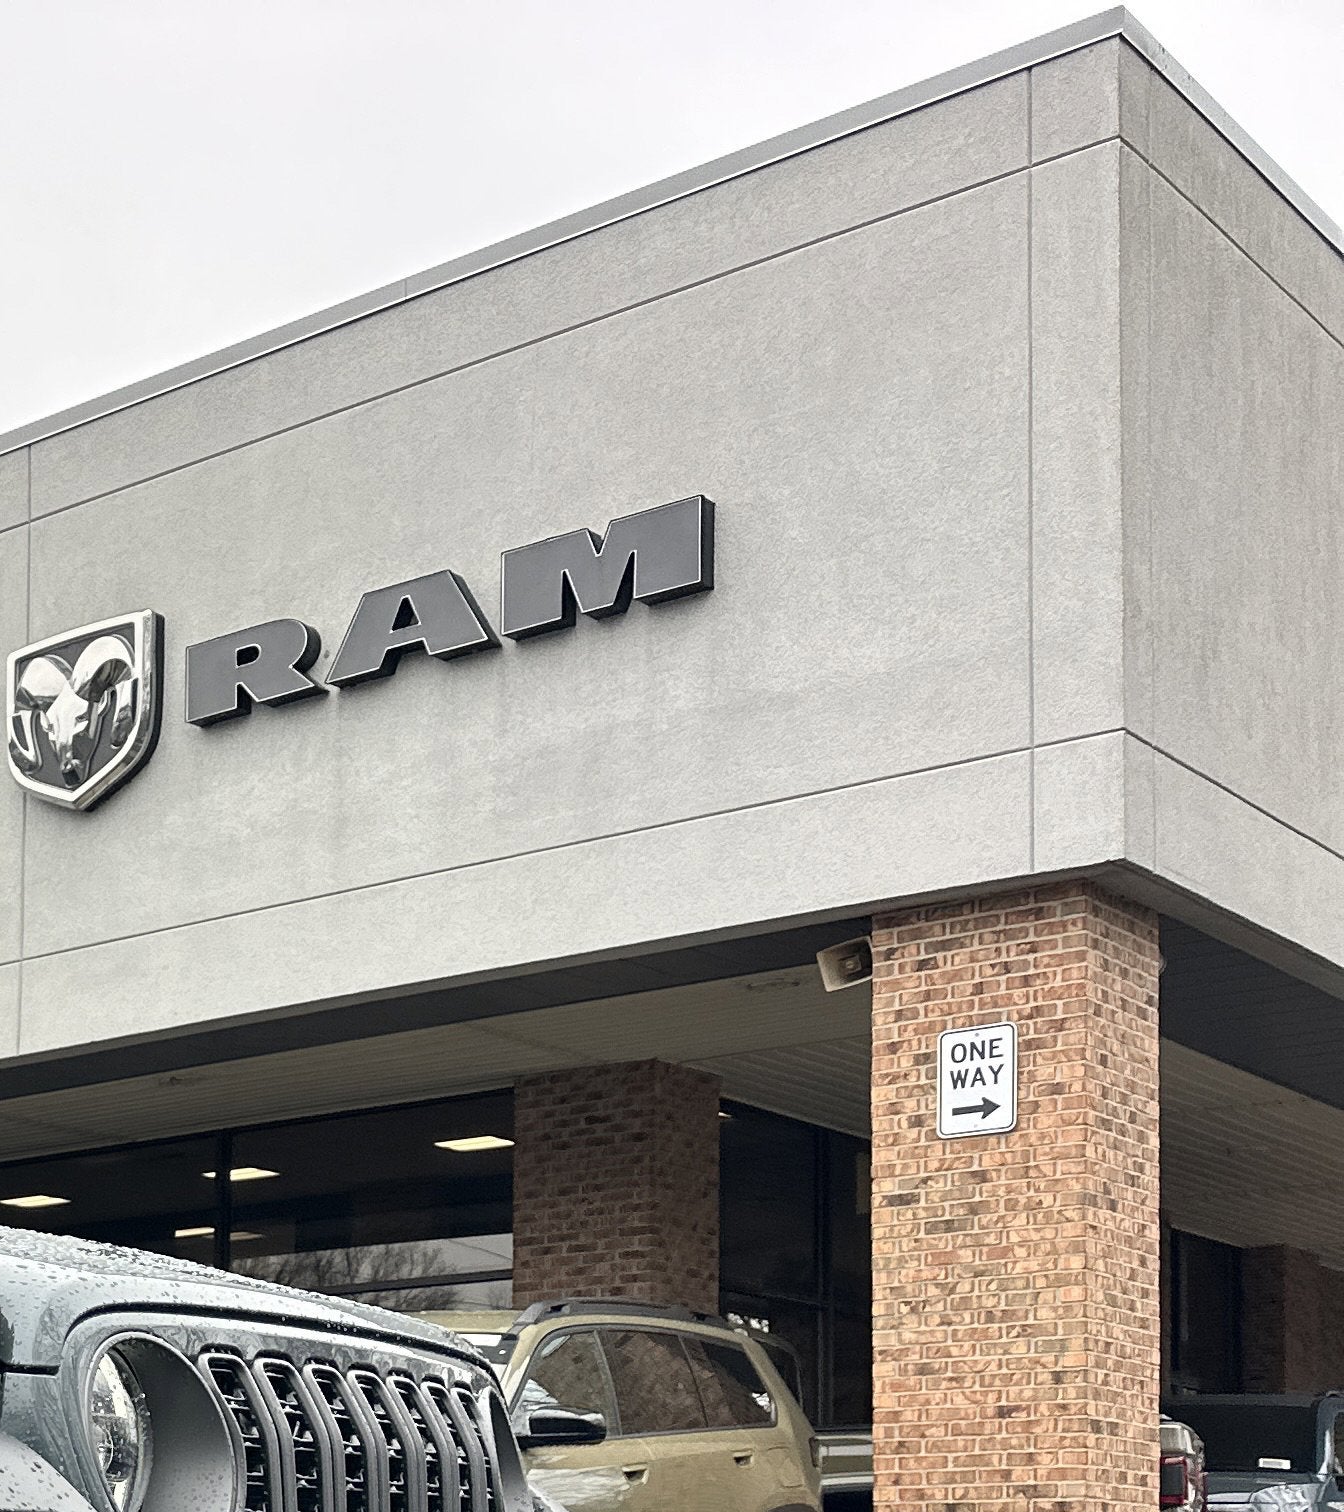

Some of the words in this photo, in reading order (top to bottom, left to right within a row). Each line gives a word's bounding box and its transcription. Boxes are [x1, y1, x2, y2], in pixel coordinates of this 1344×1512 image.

[185, 494, 714, 728] RAM
[950, 1037, 1004, 1064] ONE
[949, 1063, 1005, 1090] WAY
